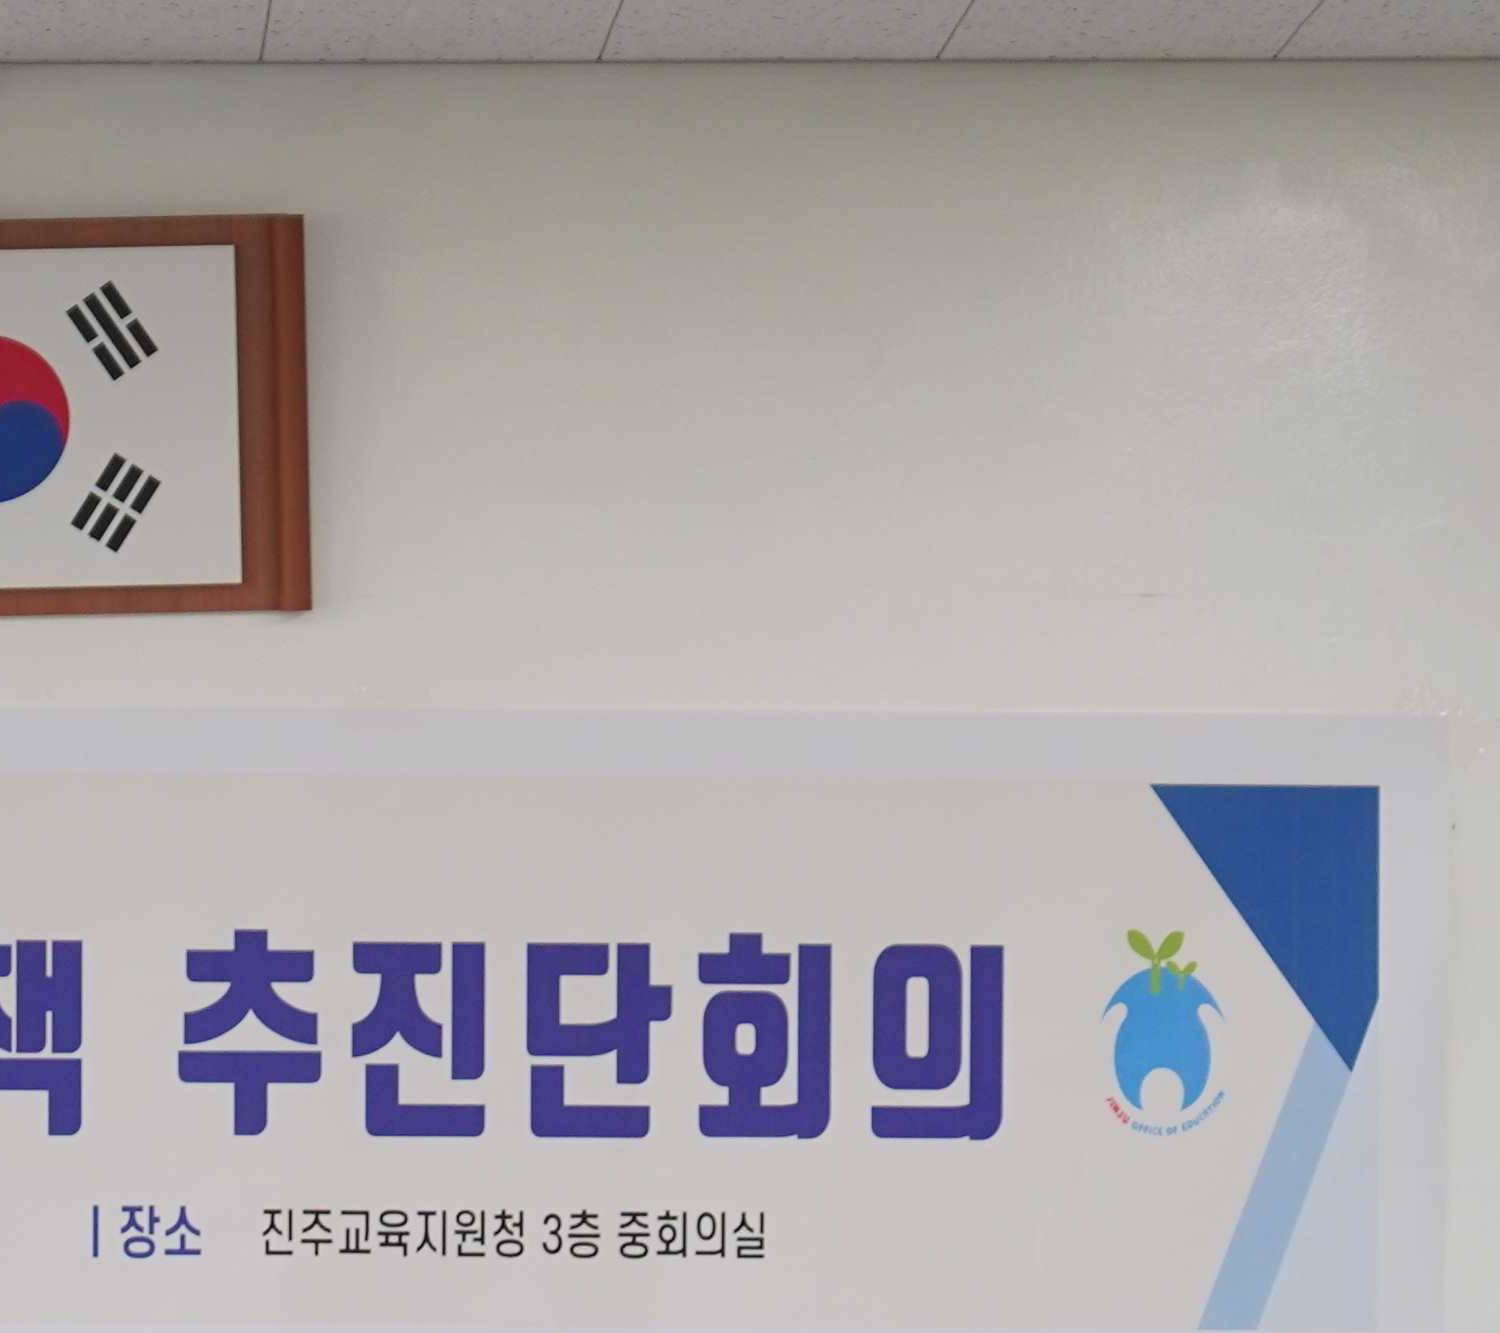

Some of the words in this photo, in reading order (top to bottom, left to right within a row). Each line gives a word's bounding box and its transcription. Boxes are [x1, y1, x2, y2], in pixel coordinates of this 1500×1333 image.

[177, 928, 1005, 1141] 추진단회의
[120, 1204, 202, 1259] 장소
[261, 1208, 526, 1258] 진주교육지원청
[541, 1208, 601, 1259] 3층
[616, 1209, 766, 1259] 중회의실
